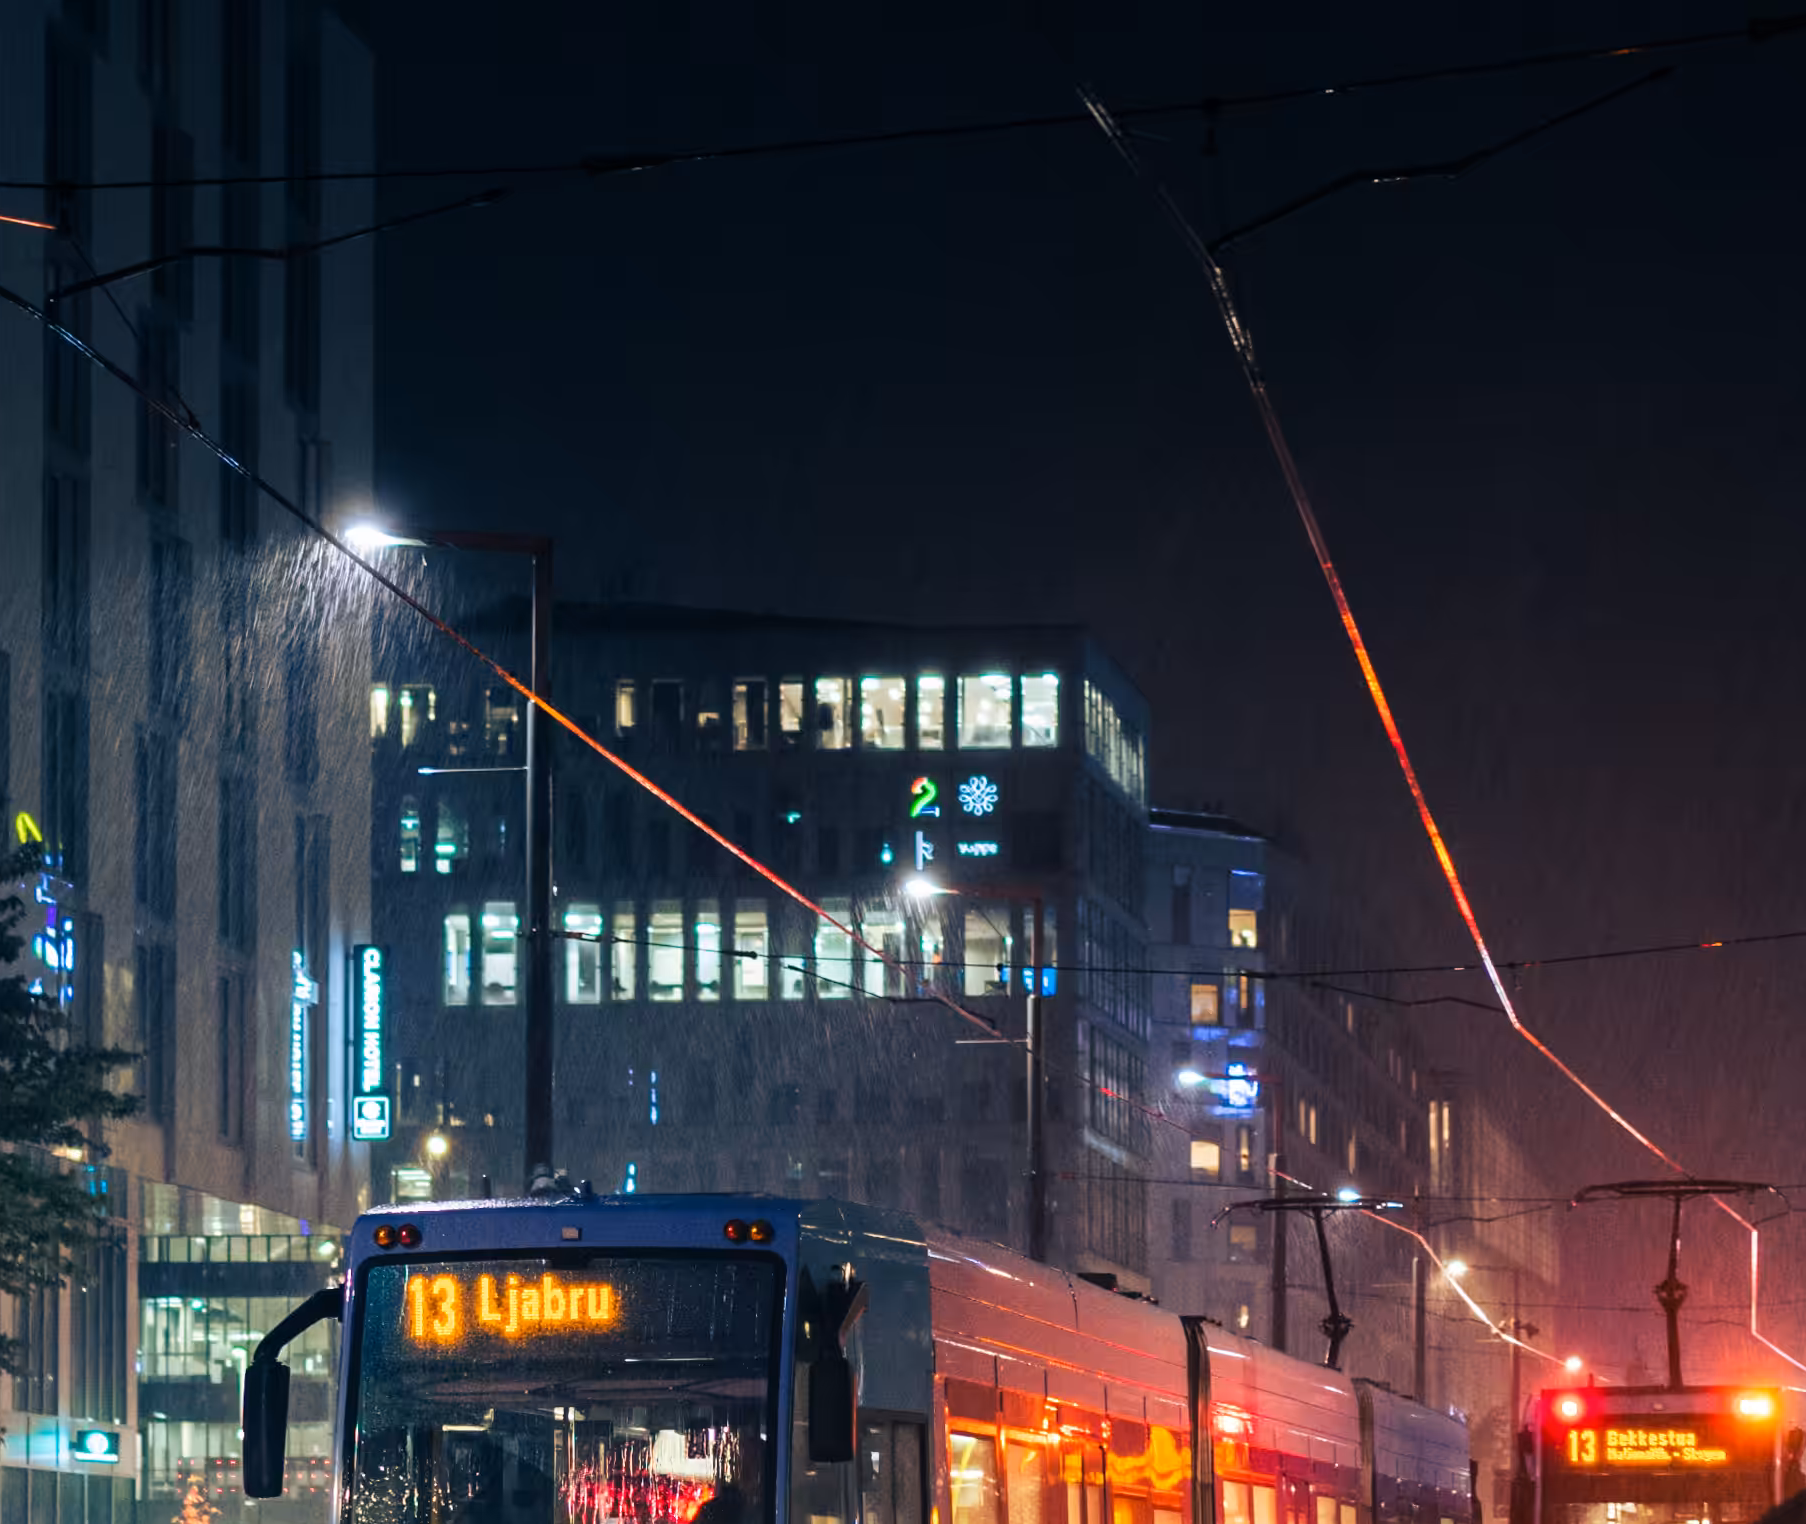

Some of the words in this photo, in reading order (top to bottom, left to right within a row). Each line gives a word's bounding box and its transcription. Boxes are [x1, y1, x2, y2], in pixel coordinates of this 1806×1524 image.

[408, 1276, 457, 1337] 13
[480, 1275, 613, 1334] Ljabru
[1568, 1429, 1596, 1463] 13
